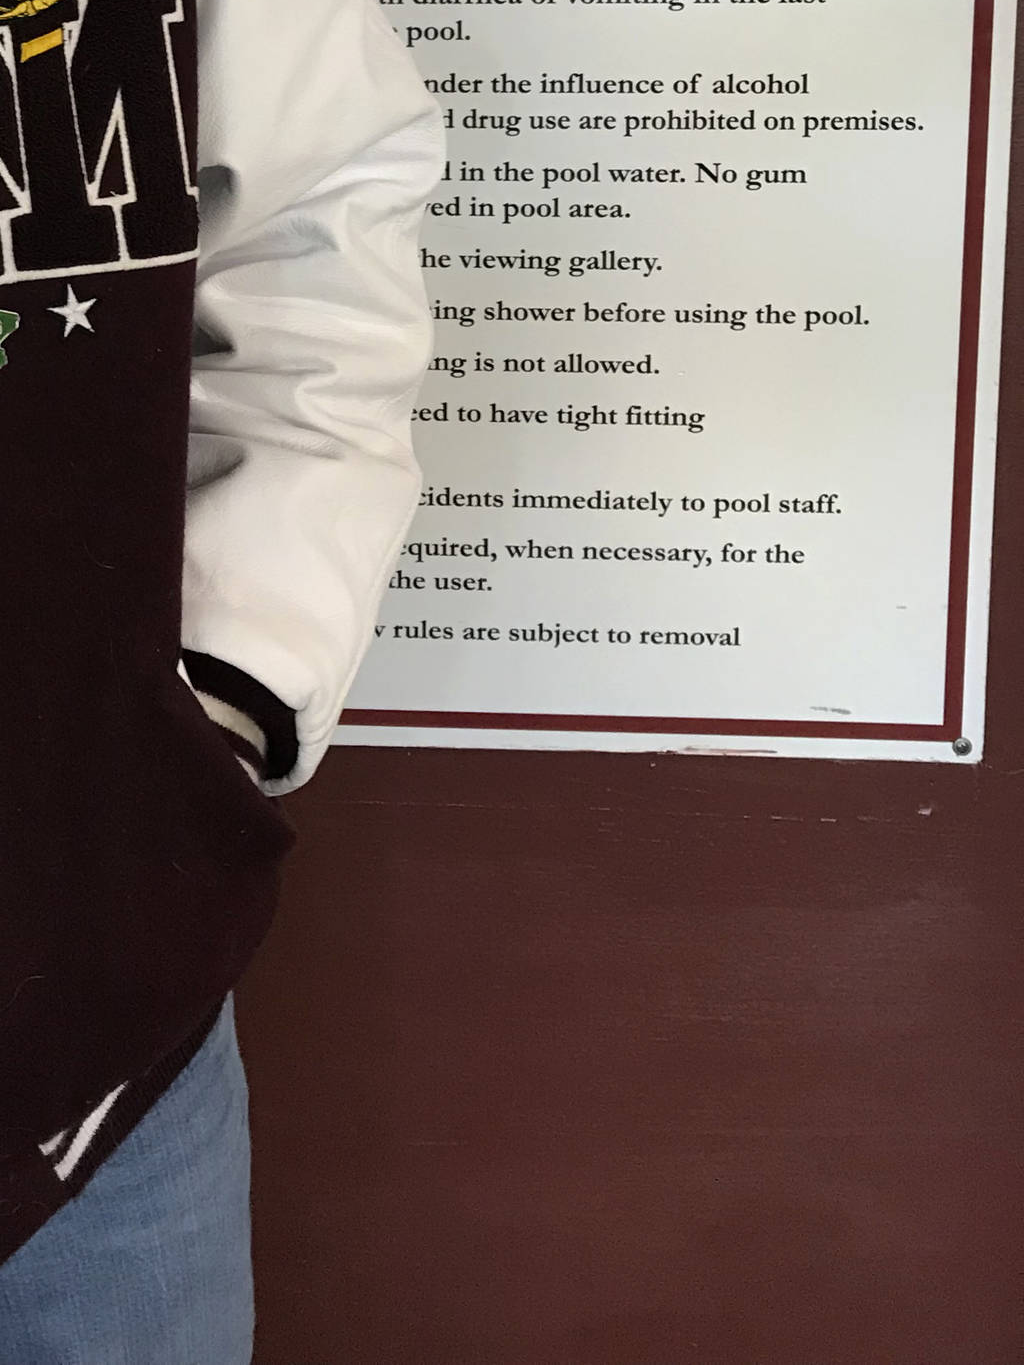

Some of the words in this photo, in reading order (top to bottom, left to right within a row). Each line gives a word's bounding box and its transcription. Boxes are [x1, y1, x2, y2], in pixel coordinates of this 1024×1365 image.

[405, 20, 471, 48] pool.
[490, 73, 532, 94] the
[539, 73, 664, 94] influence
[712, 73, 810, 94] alcohol
[462, 108, 522, 137] drug
[528, 115, 571, 130] use
[578, 115, 617, 130] are
[623, 109, 756, 137] prohibited
[802, 109, 924, 138] premises.
[493, 161, 535, 182] the
[541, 162, 601, 189] pool
[608, 167, 686, 183] water.
[745, 169, 807, 191] gum
[502, 197, 561, 224] pool
[568, 203, 631, 218] area.
[458, 248, 562, 277] viewing
[568, 250, 662, 277] gallery.
[483, 300, 576, 322] shower
[582, 301, 666, 323] before
[674, 303, 748, 331] using
[755, 304, 796, 324] the
[803, 305, 869, 332] pool.
[502, 357, 546, 372] not
[553, 353, 660, 374] allowed.
[489, 403, 549, 424] have
[556, 404, 618, 432] tight
[624, 405, 706, 434] fitting
[512, 488, 674, 517] immediately
[712, 493, 771, 519] pool
[778, 494, 841, 514] staff.
[504, 539, 574, 559] when
[581, 546, 712, 568] necessary,
[720, 543, 757, 563] for
[764, 544, 805, 564] the
[433, 577, 492, 591] user.
[393, 620, 454, 640] rules
[462, 627, 500, 641] are
[508, 623, 599, 648] subject
[639, 627, 741, 646] removal
